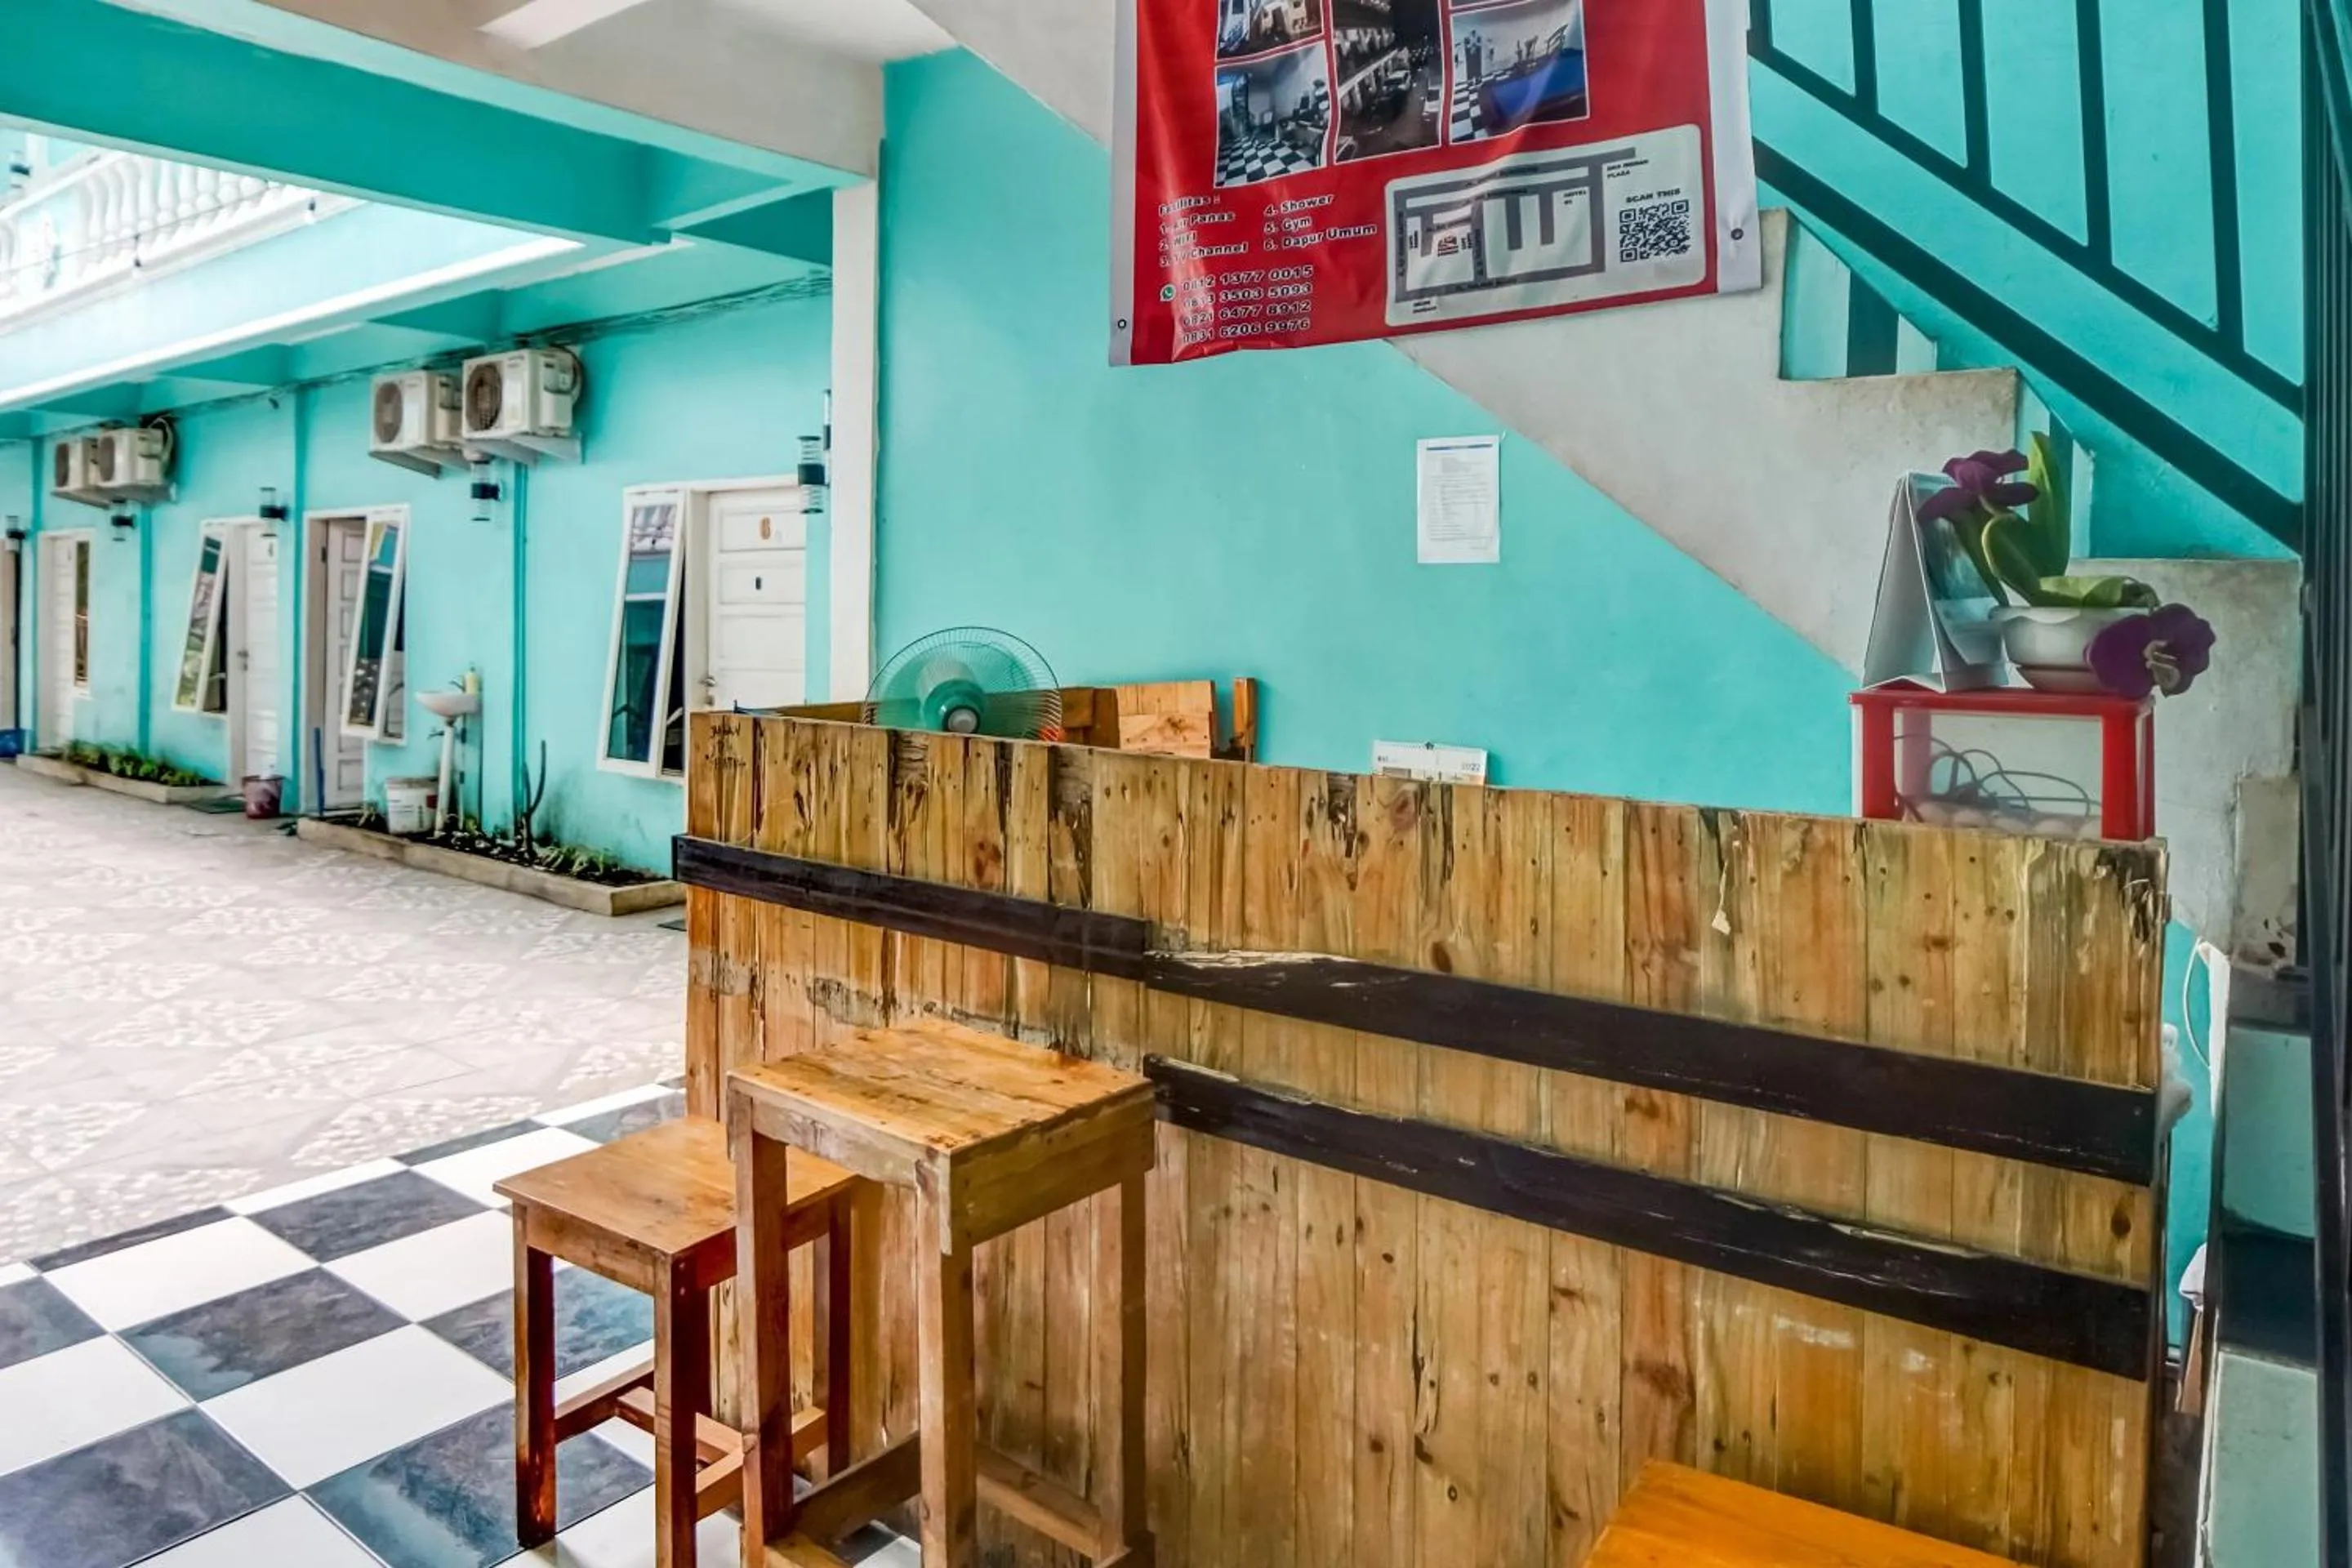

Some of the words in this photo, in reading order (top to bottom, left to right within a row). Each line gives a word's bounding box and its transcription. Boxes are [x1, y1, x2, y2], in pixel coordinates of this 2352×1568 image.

[1281, 194, 1334, 213] Shower
[1625, 193, 1654, 203] SCAN
[1656, 188, 1682, 198] THIS
[1190, 212, 1236, 225] Panas
[1281, 216, 1312, 233] Gym
[1282, 233, 1325, 248] Dapur
[1326, 223, 1378, 240] Umum
[1192, 241, 1248, 259] Channel
[1219, 270, 1265, 284] 1377
[1268, 264, 1314, 280] 0015
[1219, 289, 1263, 302] 3503
[1267, 283, 1313, 298] 5093
[1219, 305, 1263, 320] 6477
[1267, 300, 1311, 315] 8912
[1219, 323, 1262, 338] 6206
[1266, 318, 1310, 332] 9976
